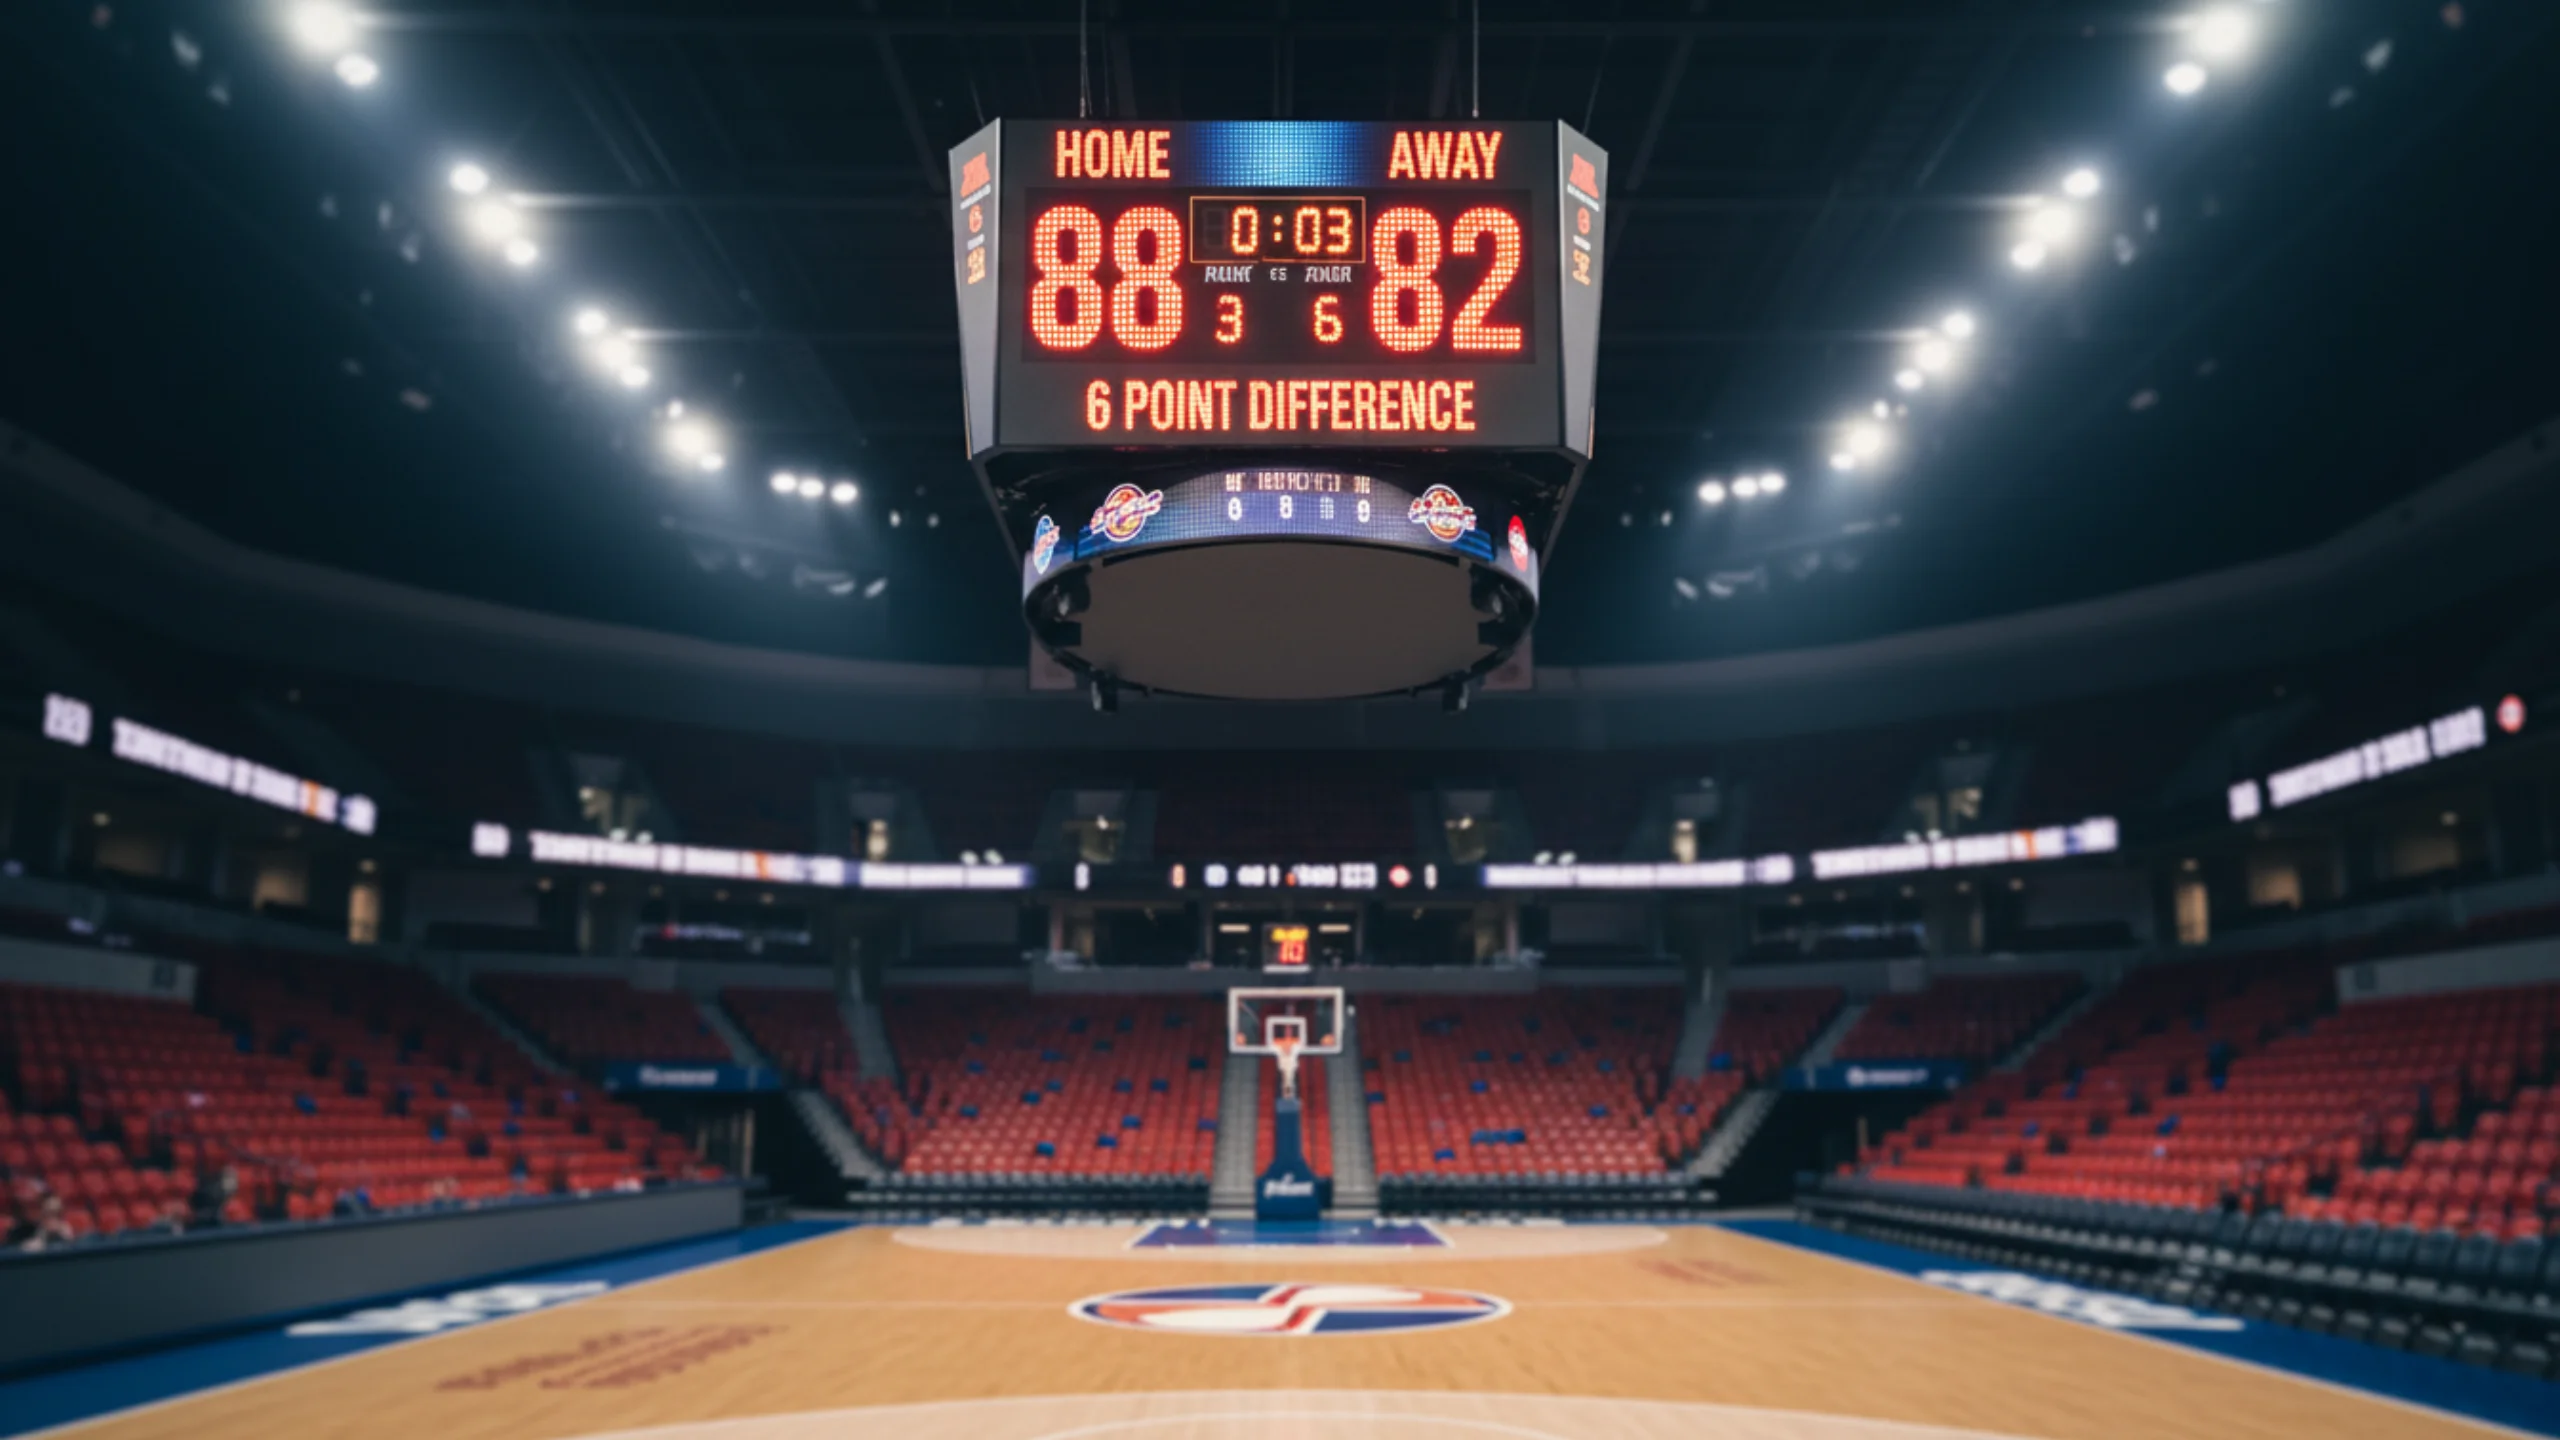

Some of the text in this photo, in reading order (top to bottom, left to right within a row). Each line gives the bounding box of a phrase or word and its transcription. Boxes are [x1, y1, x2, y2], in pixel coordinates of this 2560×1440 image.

[1056, 129, 1171, 179] HOME
[1388, 131, 1502, 180] AWAY
[1031, 205, 1184, 351] 88
[1371, 206, 1522, 352] 82
[1215, 294, 1243, 343] 3
[1313, 294, 1343, 343] 6
[1086, 379, 1476, 431] 6 POINT DIFFERENCE
